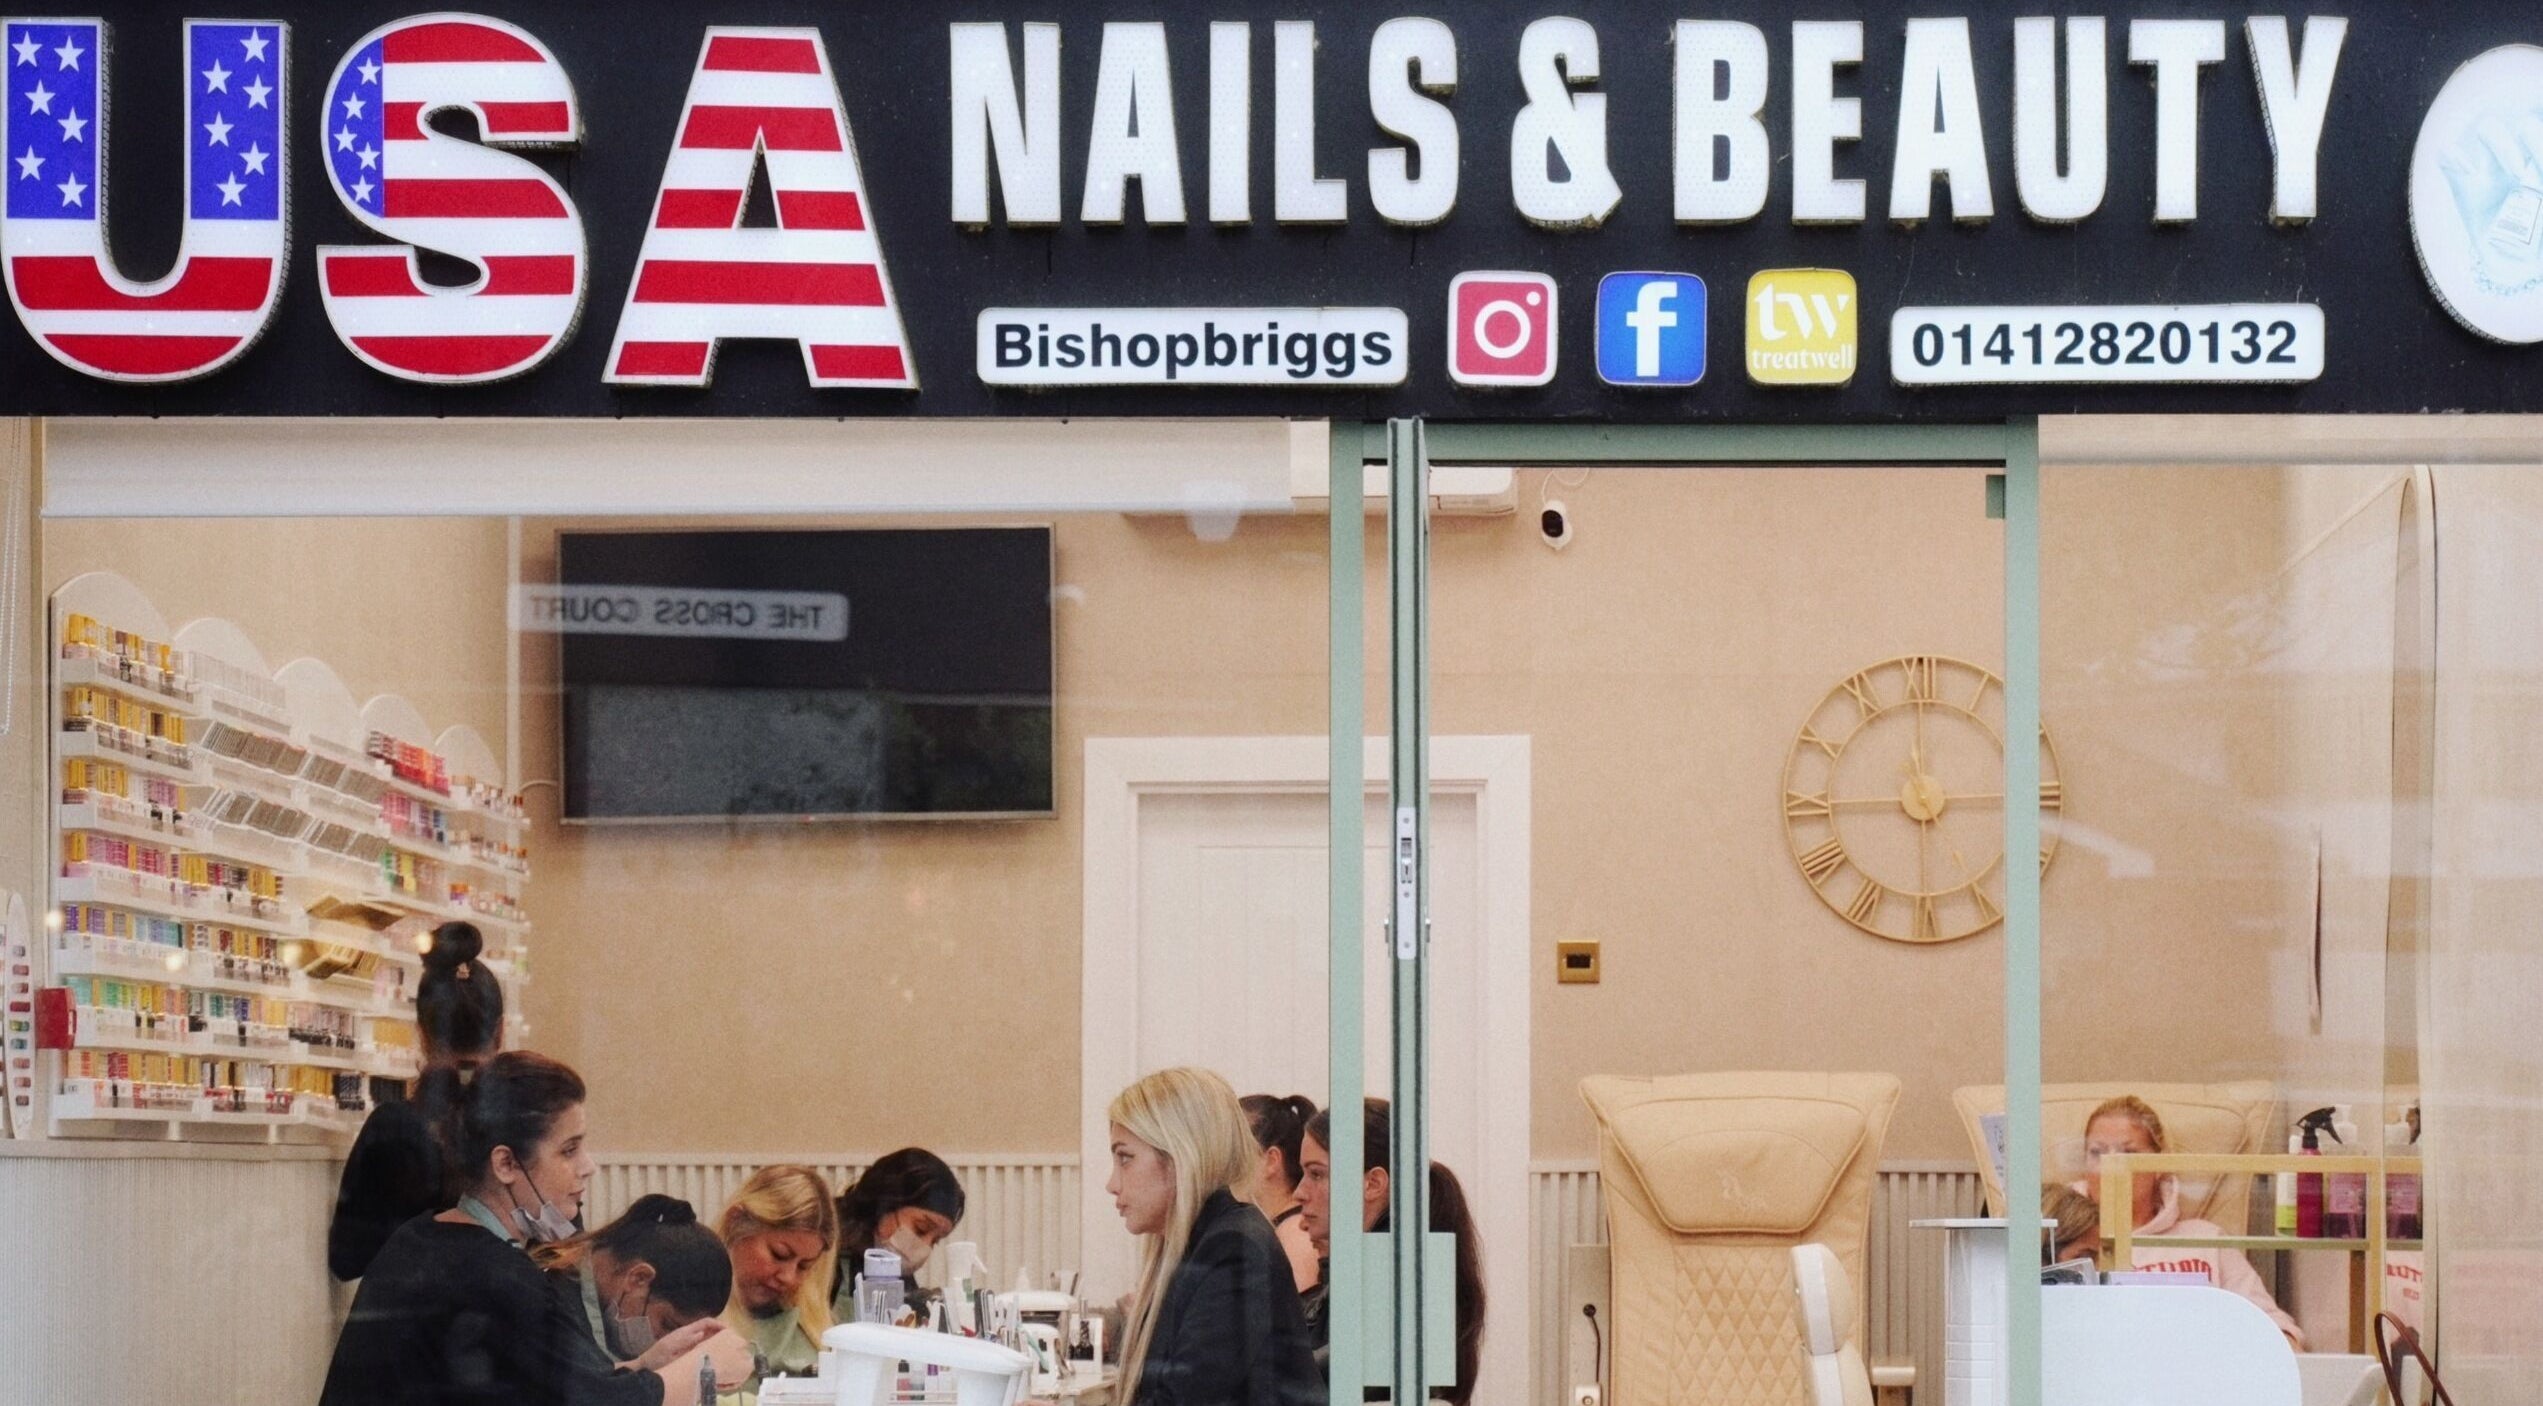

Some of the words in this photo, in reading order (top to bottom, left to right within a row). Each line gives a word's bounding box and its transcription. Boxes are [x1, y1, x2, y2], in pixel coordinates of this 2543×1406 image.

[950, 16, 1459, 226] NAILS
[1511, 16, 1622, 226] &
[1671, 16, 2348, 224] BEAUTY
[0, 12, 917, 388] USA
[1754, 283, 1850, 341] tw
[997, 323, 1392, 379] Bishopbriggs
[1752, 344, 1853, 370] treatwell
[1912, 322, 2297, 366] 01412820132
